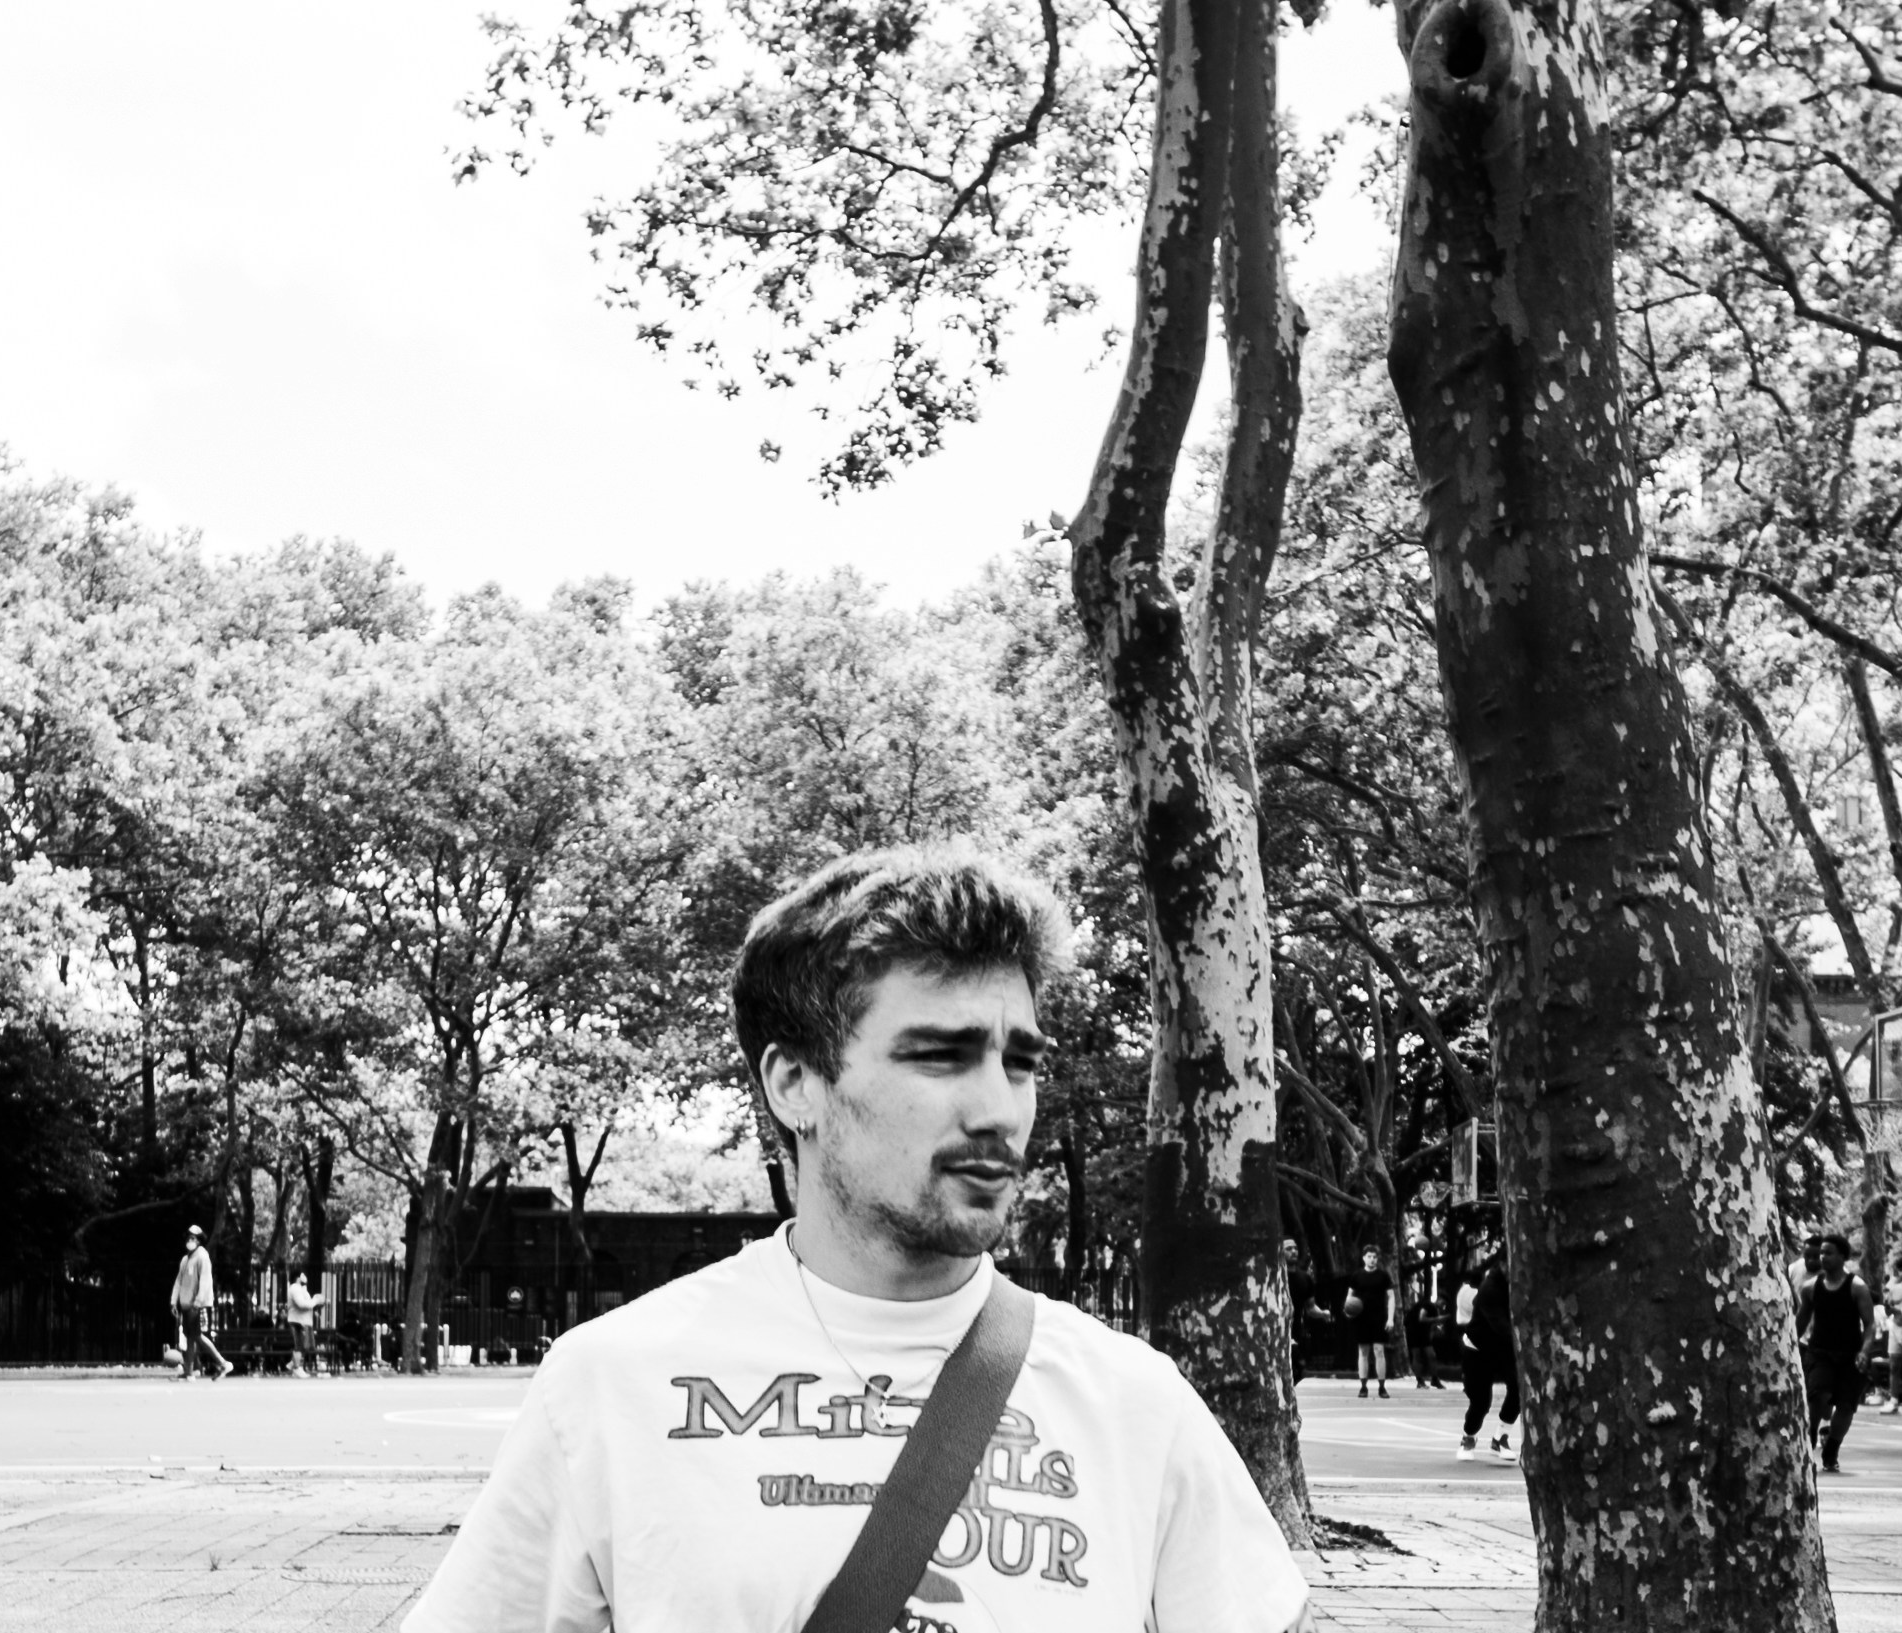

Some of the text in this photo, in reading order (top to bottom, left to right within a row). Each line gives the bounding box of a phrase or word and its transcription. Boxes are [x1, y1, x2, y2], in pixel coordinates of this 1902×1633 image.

[667, 1373, 1040, 1446] Mite
[757, 1475, 885, 1507] Ultima
[930, 1507, 1089, 1588] OUR
